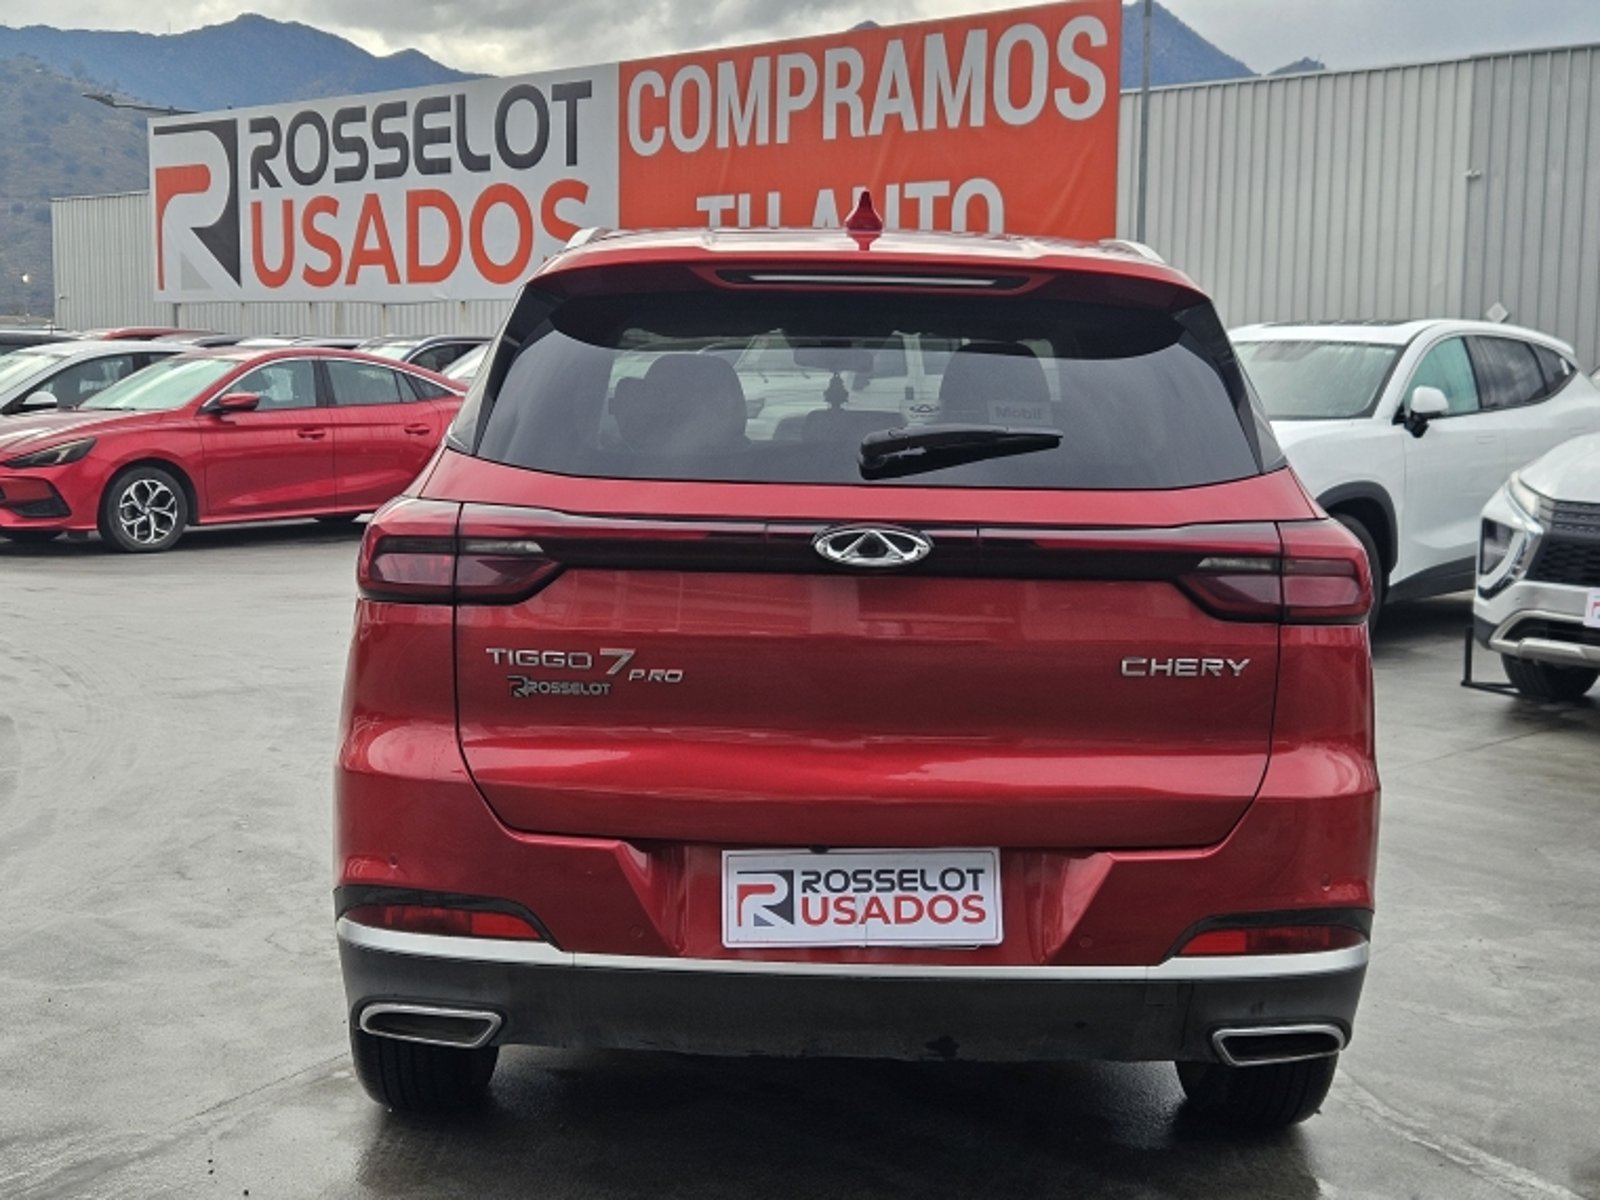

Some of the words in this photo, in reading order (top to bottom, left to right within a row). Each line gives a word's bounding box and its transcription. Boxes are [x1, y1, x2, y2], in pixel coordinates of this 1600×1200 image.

[627, 15, 1108, 156] COMPRAMOS
[249, 80, 592, 189] ROSSELOT
[251, 178, 589, 289] USADOS
[995, 406, 1042, 420] Mobil
[485, 647, 593, 669] TIGGO
[599, 648, 636, 675] 7
[629, 669, 684, 683] PRO
[1121, 657, 1250, 677] CHERY
[526, 681, 612, 696] ROSSELOT
[801, 867, 985, 893] ROSSELOT
[801, 894, 987, 926] USADOS
